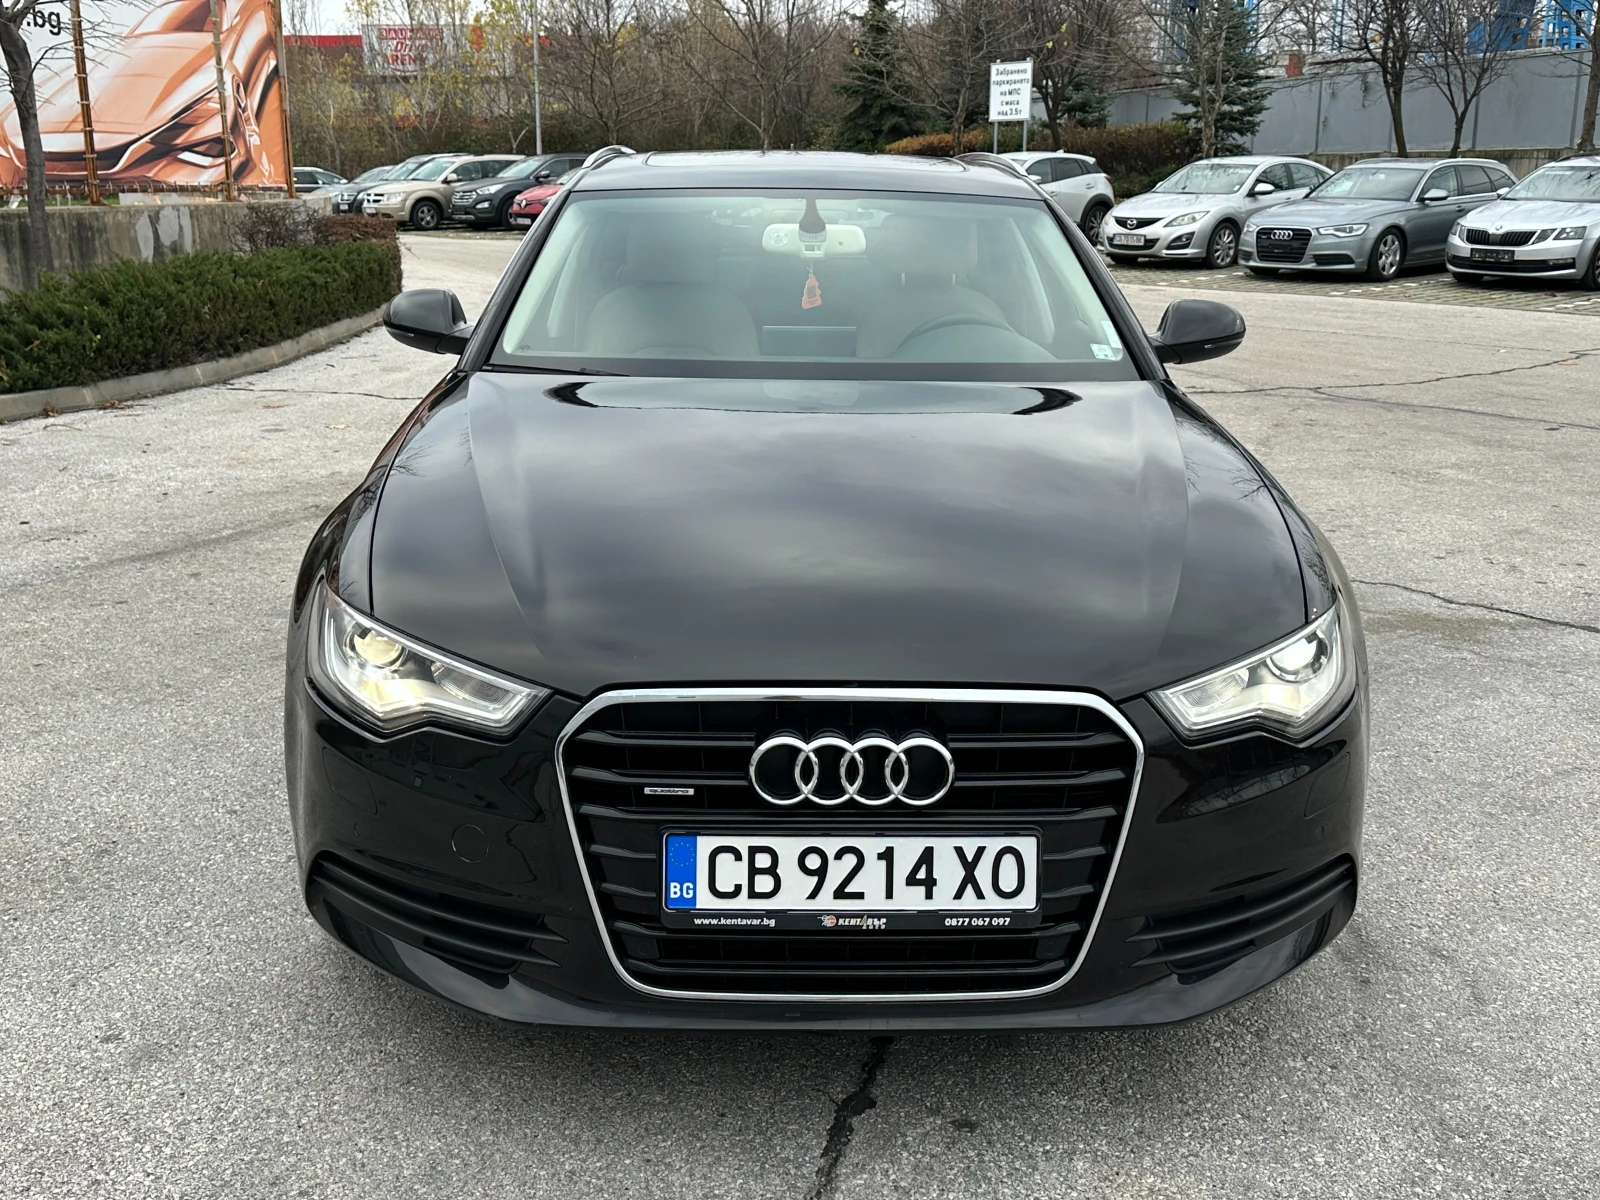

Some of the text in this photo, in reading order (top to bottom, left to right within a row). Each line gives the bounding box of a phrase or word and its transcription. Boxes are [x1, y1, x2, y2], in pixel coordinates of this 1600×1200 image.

[995, 68, 1027, 76] Забранено
[992, 78, 1030, 87] паркирането
[1008, 88, 1021, 96] МПС
[707, 845, 1026, 900] CB 9214 XO
[670, 882, 693, 898] BG
[693, 917, 776, 927] www.kentavar.bg
[944, 917, 1011, 926] 0877 067 097
